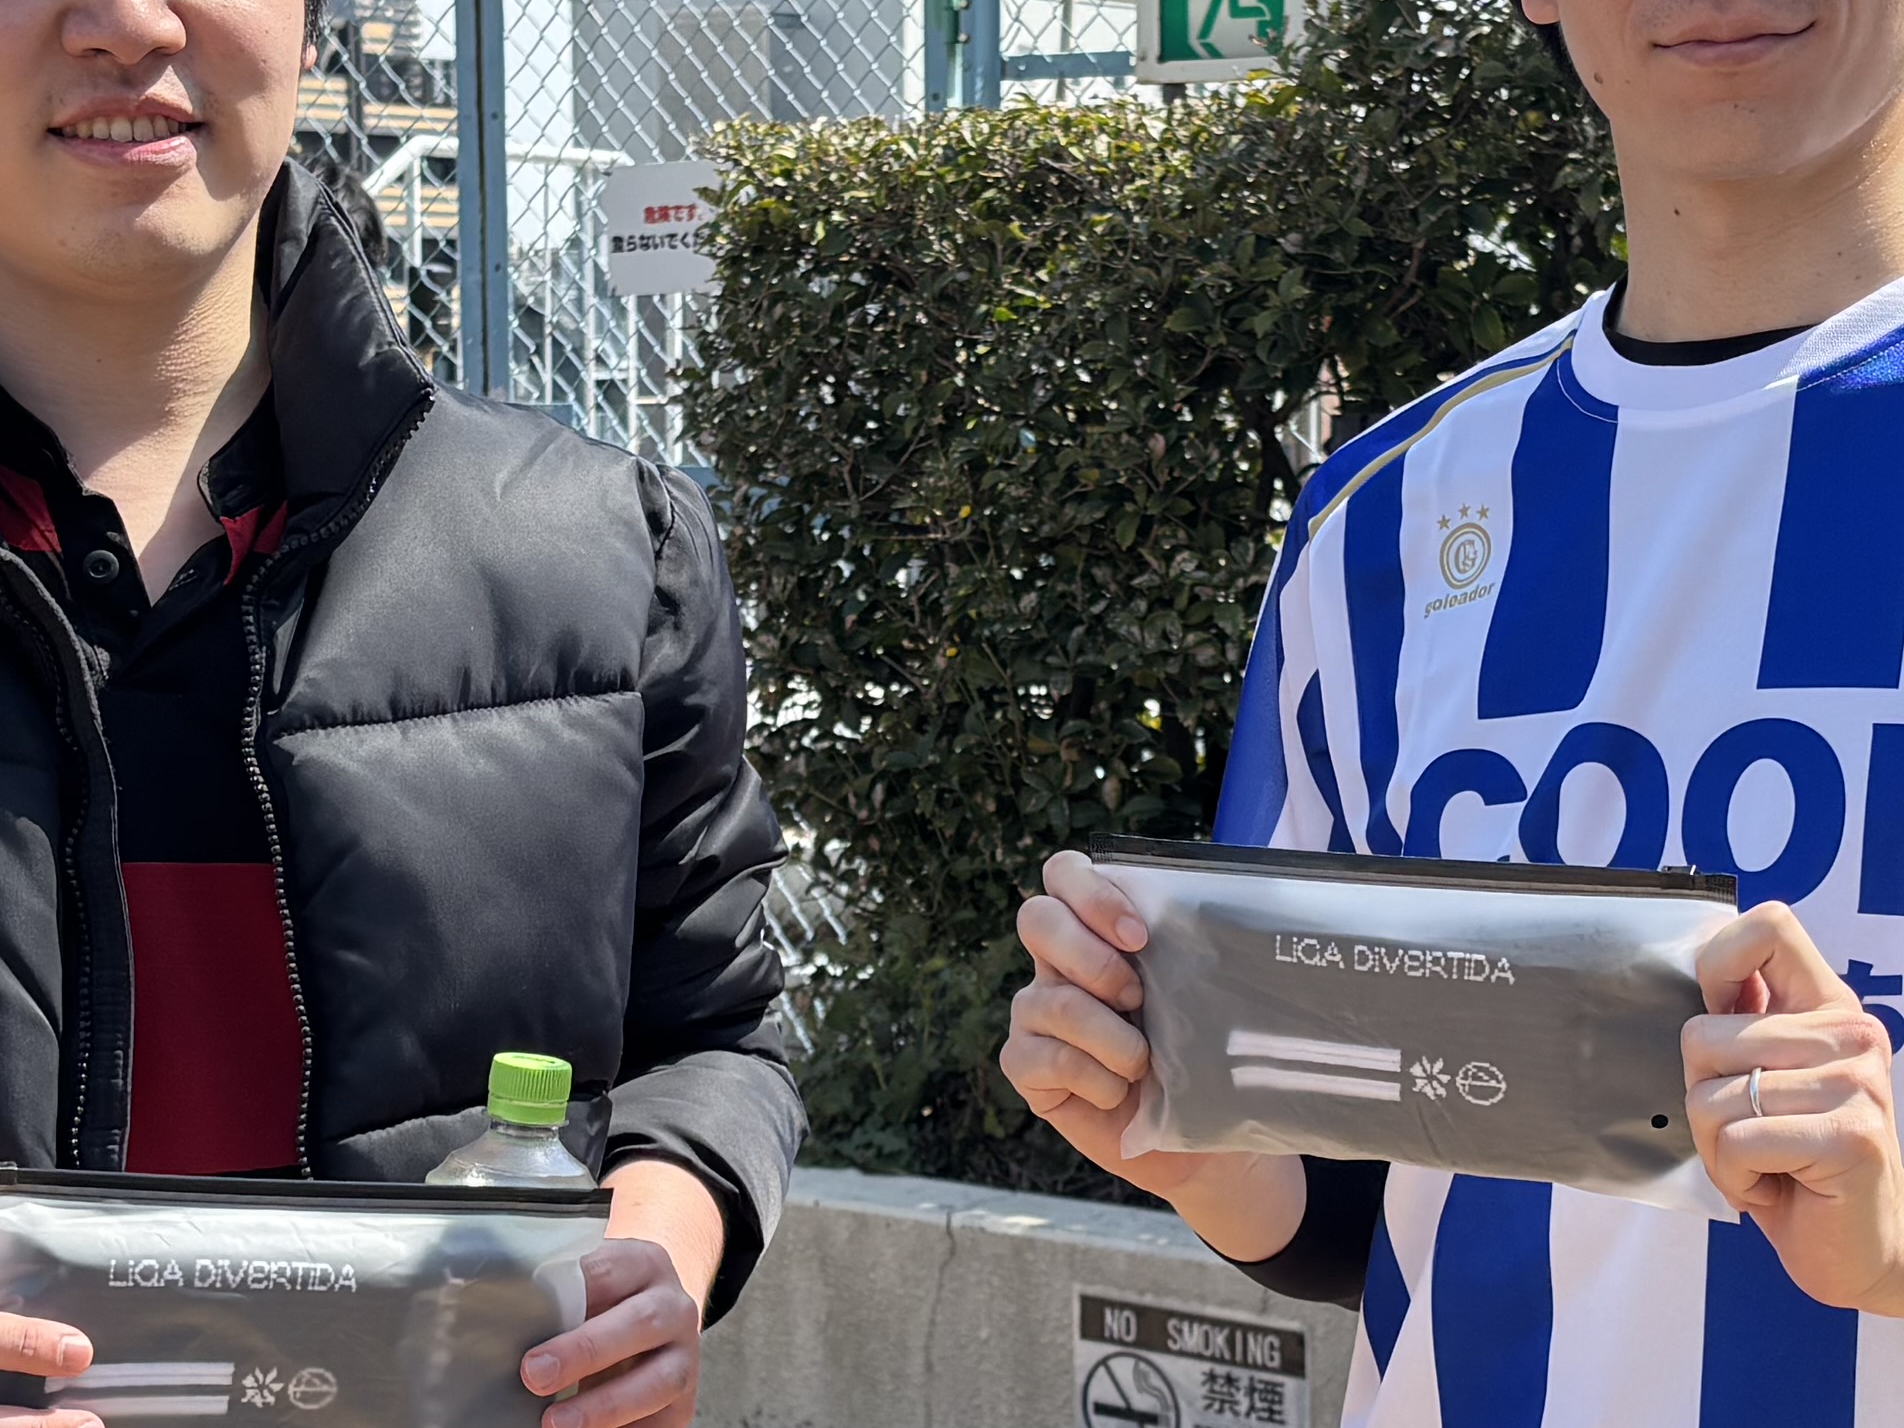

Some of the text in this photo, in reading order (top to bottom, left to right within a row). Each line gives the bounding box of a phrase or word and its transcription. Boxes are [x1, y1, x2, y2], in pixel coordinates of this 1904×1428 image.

[1424, 582, 1495, 620] goleador
[1104, 1307, 1281, 1368] NO SMOKING
[1200, 1368, 1286, 1425] 禁煙
